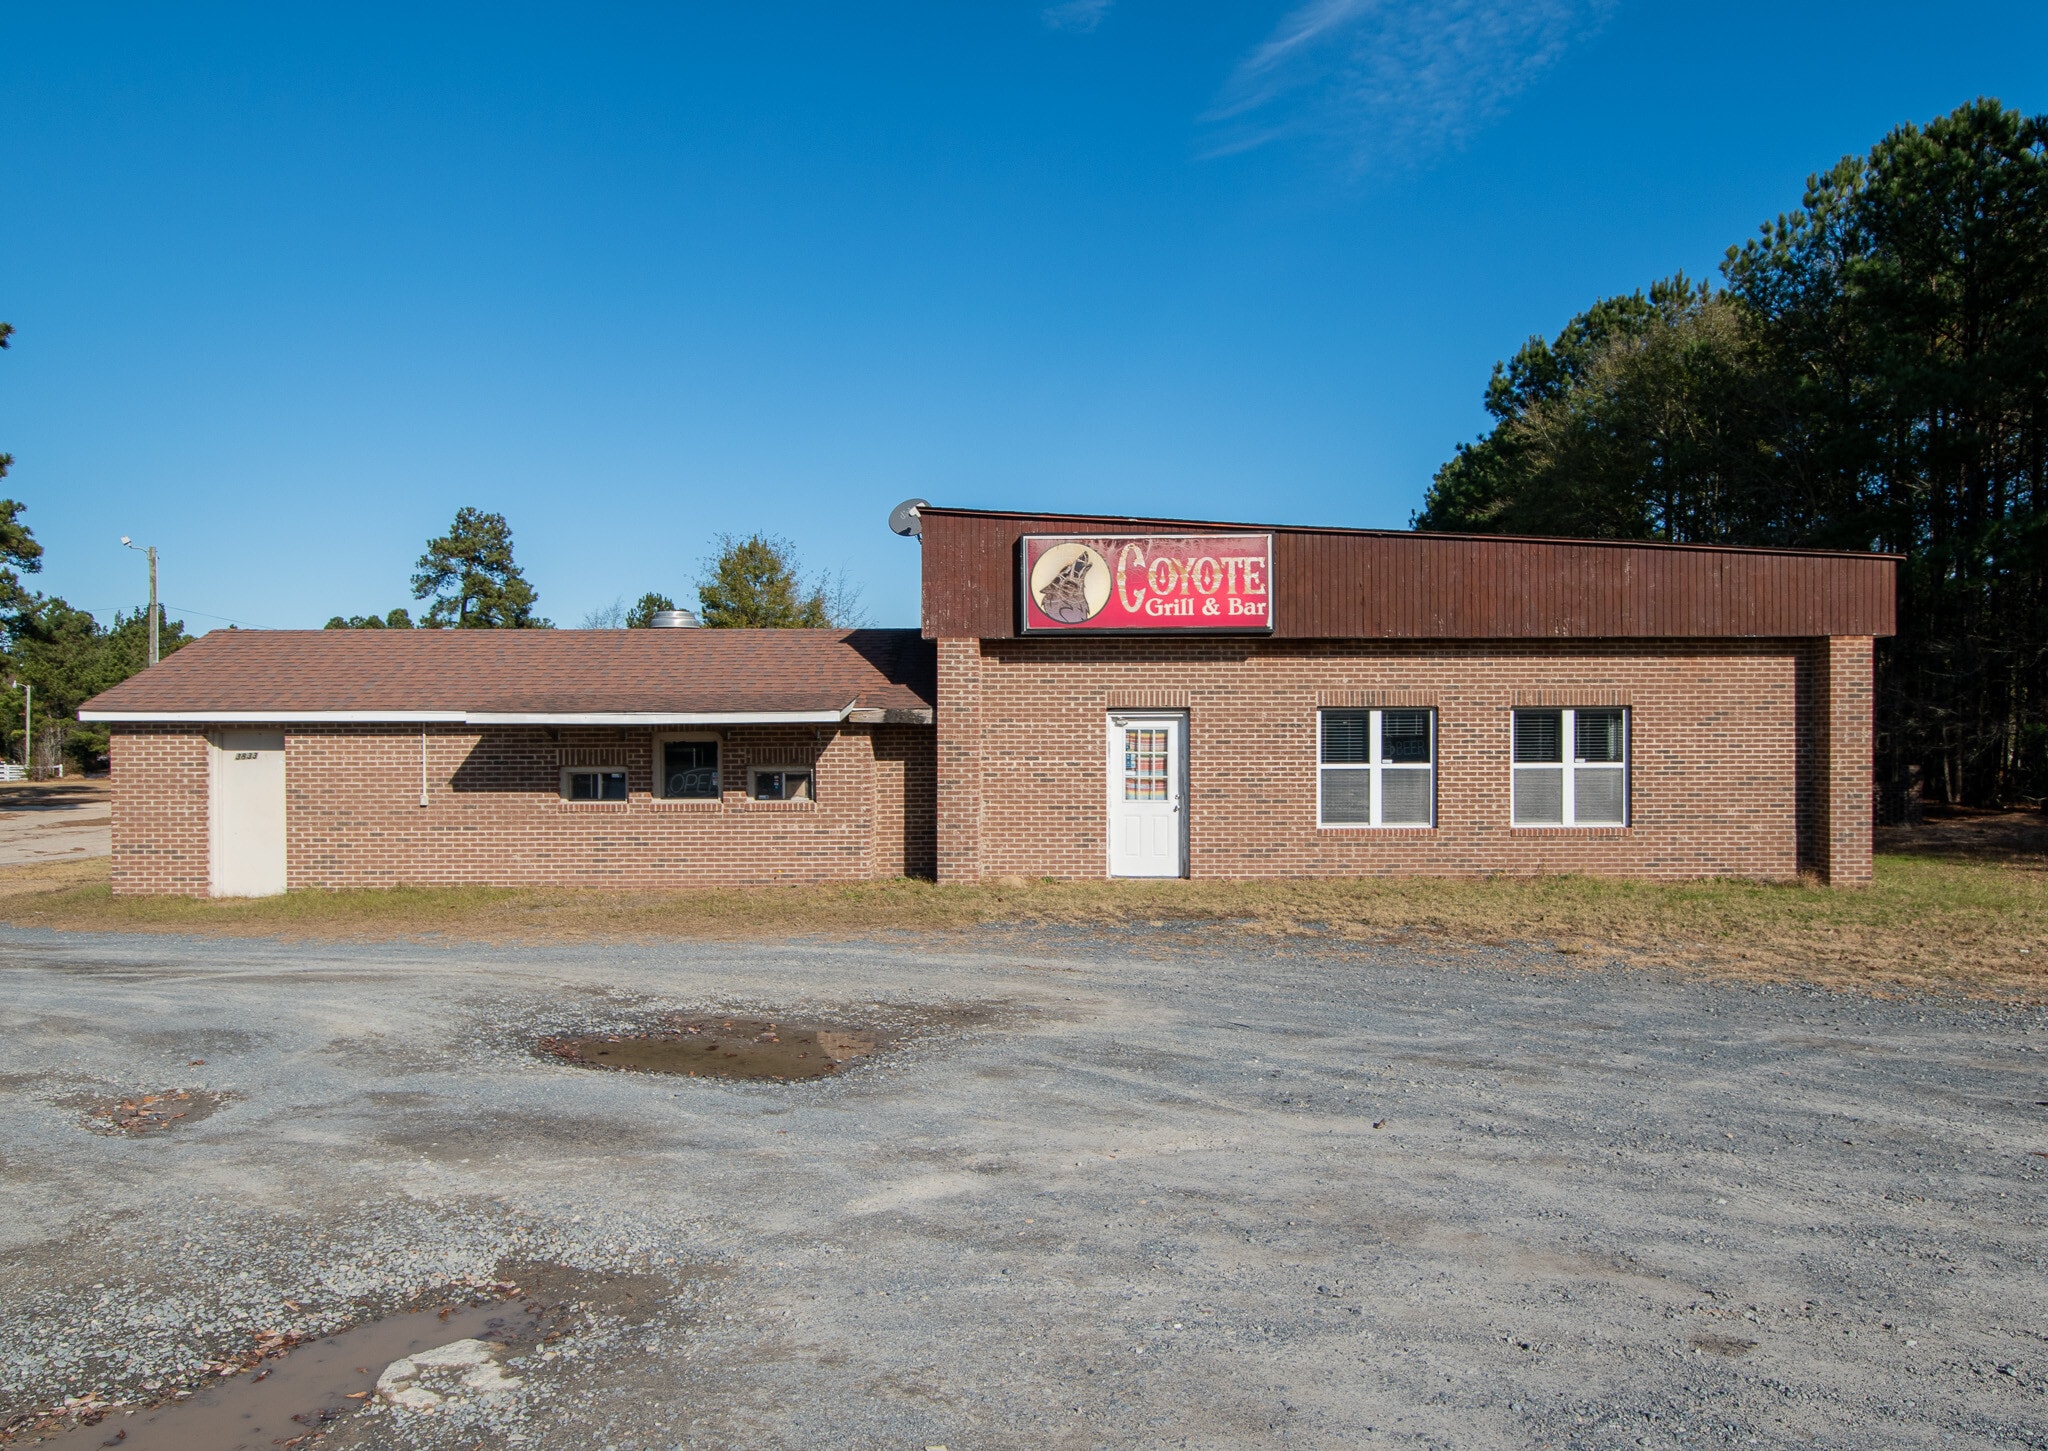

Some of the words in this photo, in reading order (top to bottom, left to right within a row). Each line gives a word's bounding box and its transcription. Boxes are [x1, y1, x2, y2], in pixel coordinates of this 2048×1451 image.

[1116, 543, 1266, 613] COYOTE
[1145, 597, 1195, 616] Grill
[1202, 598, 1221, 616] &
[1228, 598, 1267, 615] Bar
[1396, 740, 1426, 756] BEER
